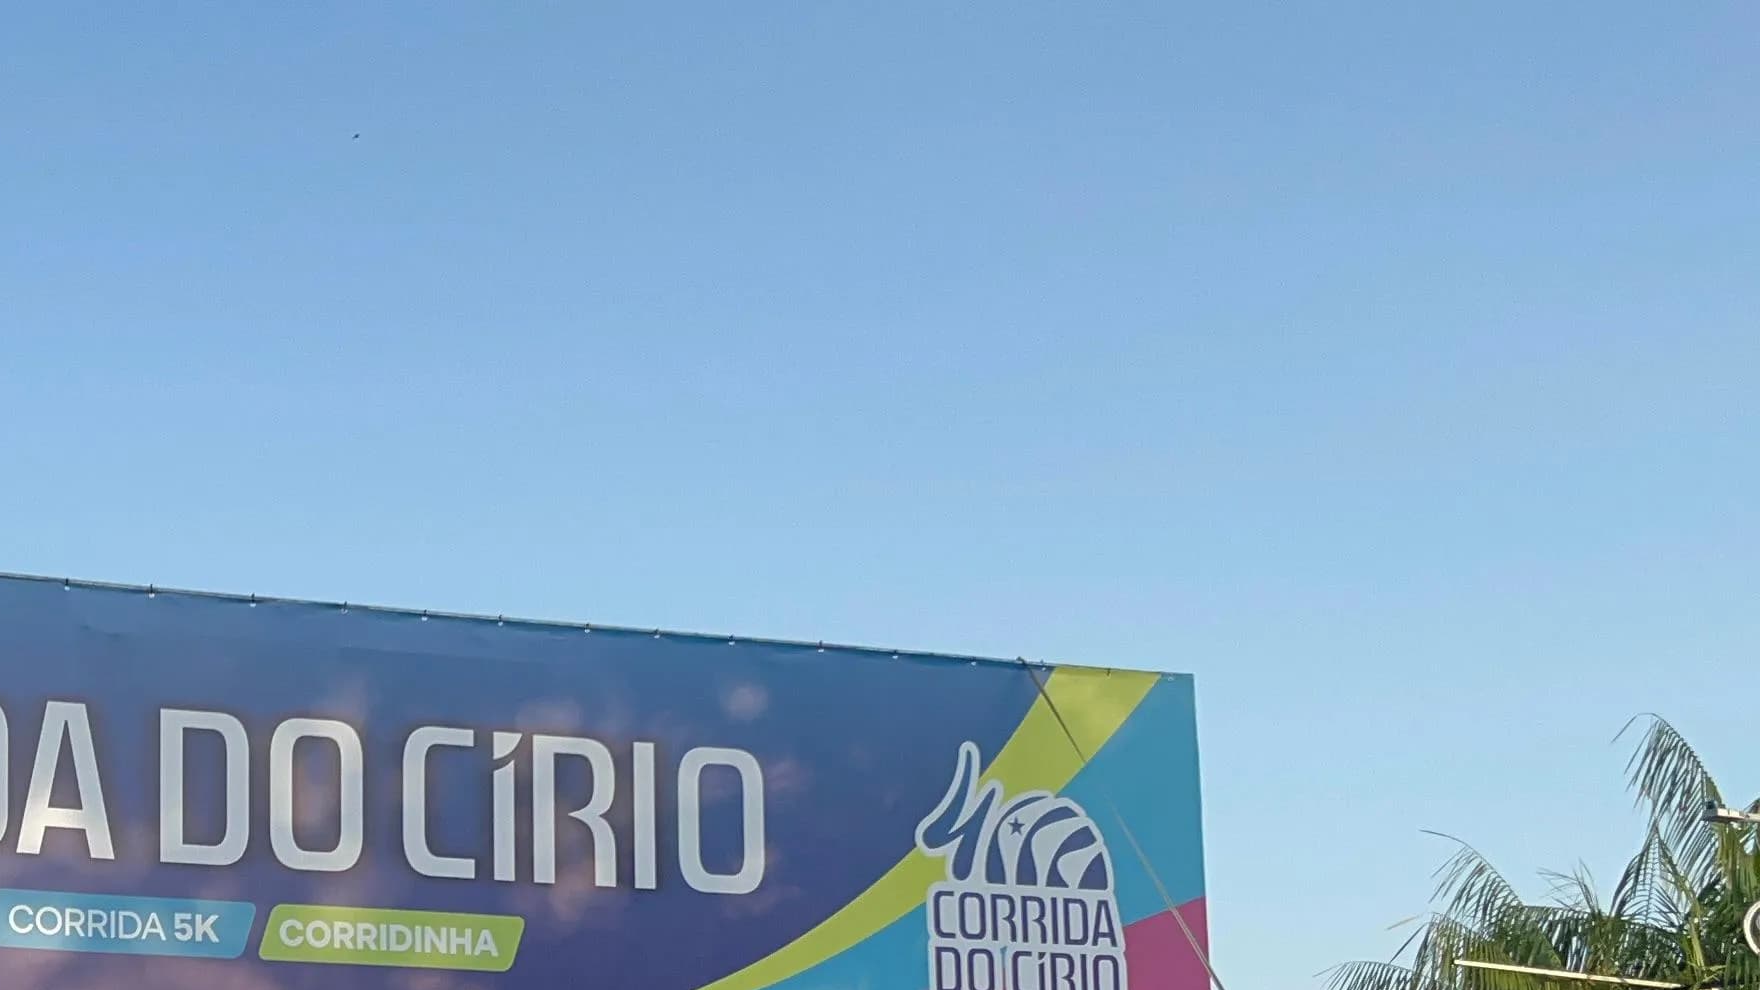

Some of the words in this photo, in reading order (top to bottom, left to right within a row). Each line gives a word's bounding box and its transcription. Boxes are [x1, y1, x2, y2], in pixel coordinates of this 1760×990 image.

[160, 708, 363, 871] DO
[403, 726, 765, 894] CÍRIO
[8, 904, 166, 942] CORRIDA
[174, 913, 220, 943] 5K
[279, 919, 499, 957] CORRIDINHA
[933, 890, 1118, 948] CORRIDA
